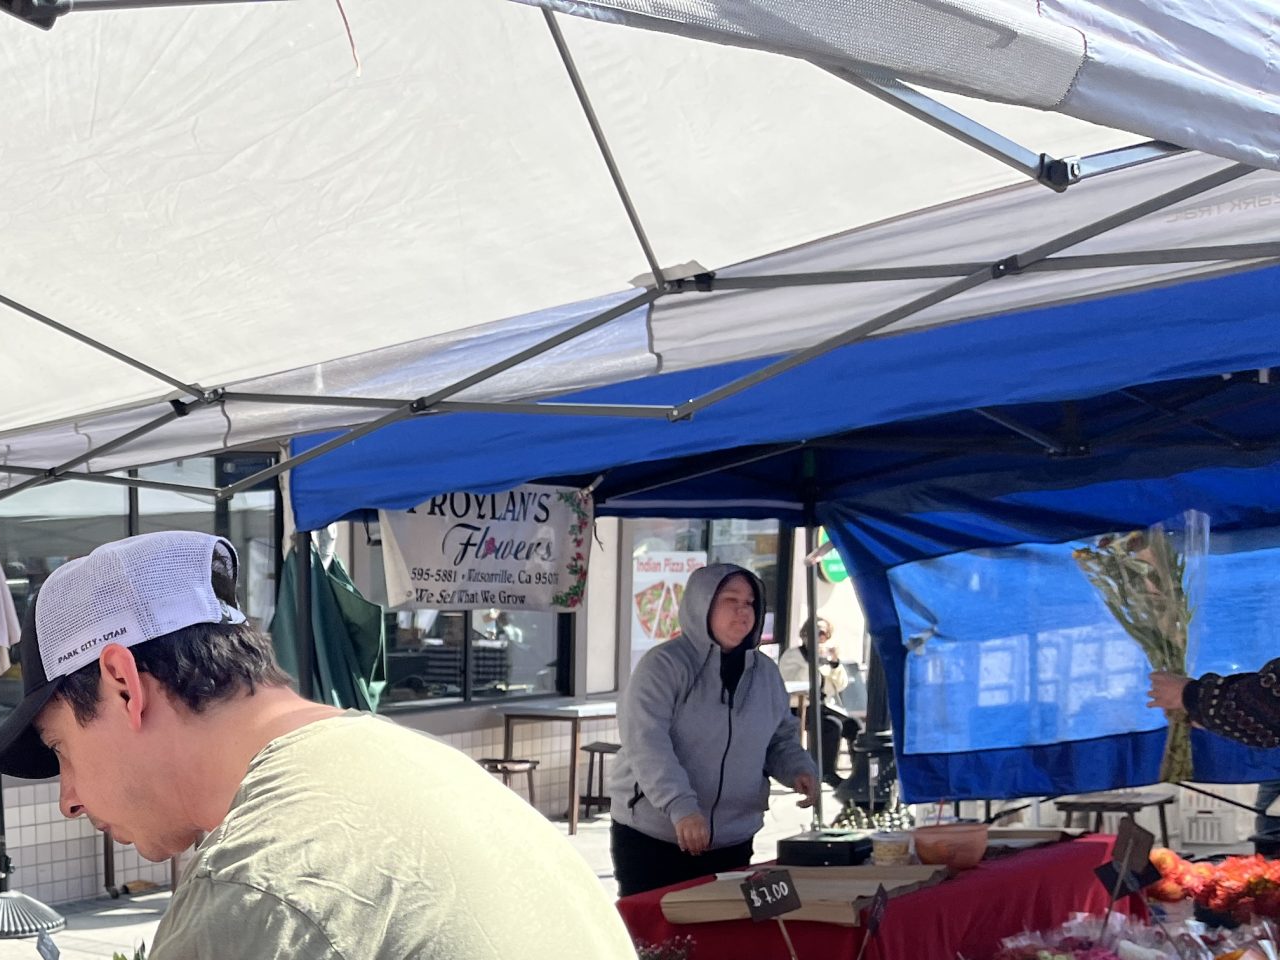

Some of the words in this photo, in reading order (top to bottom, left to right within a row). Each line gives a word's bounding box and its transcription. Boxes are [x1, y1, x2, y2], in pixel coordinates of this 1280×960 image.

[406, 491, 551, 523] ROYLAN'S
[410, 567, 457, 584] 595-5881
[518, 570, 532, 585] Ca
[415, 588, 434, 604] We
[480, 590, 496, 604] We
[498, 591, 526, 605] Grow
[57, 649, 79, 664] PARK
[80, 638, 98, 653] CITY
[103, 627, 127, 641] UTAH
[749, 881, 789, 907] $7.00
